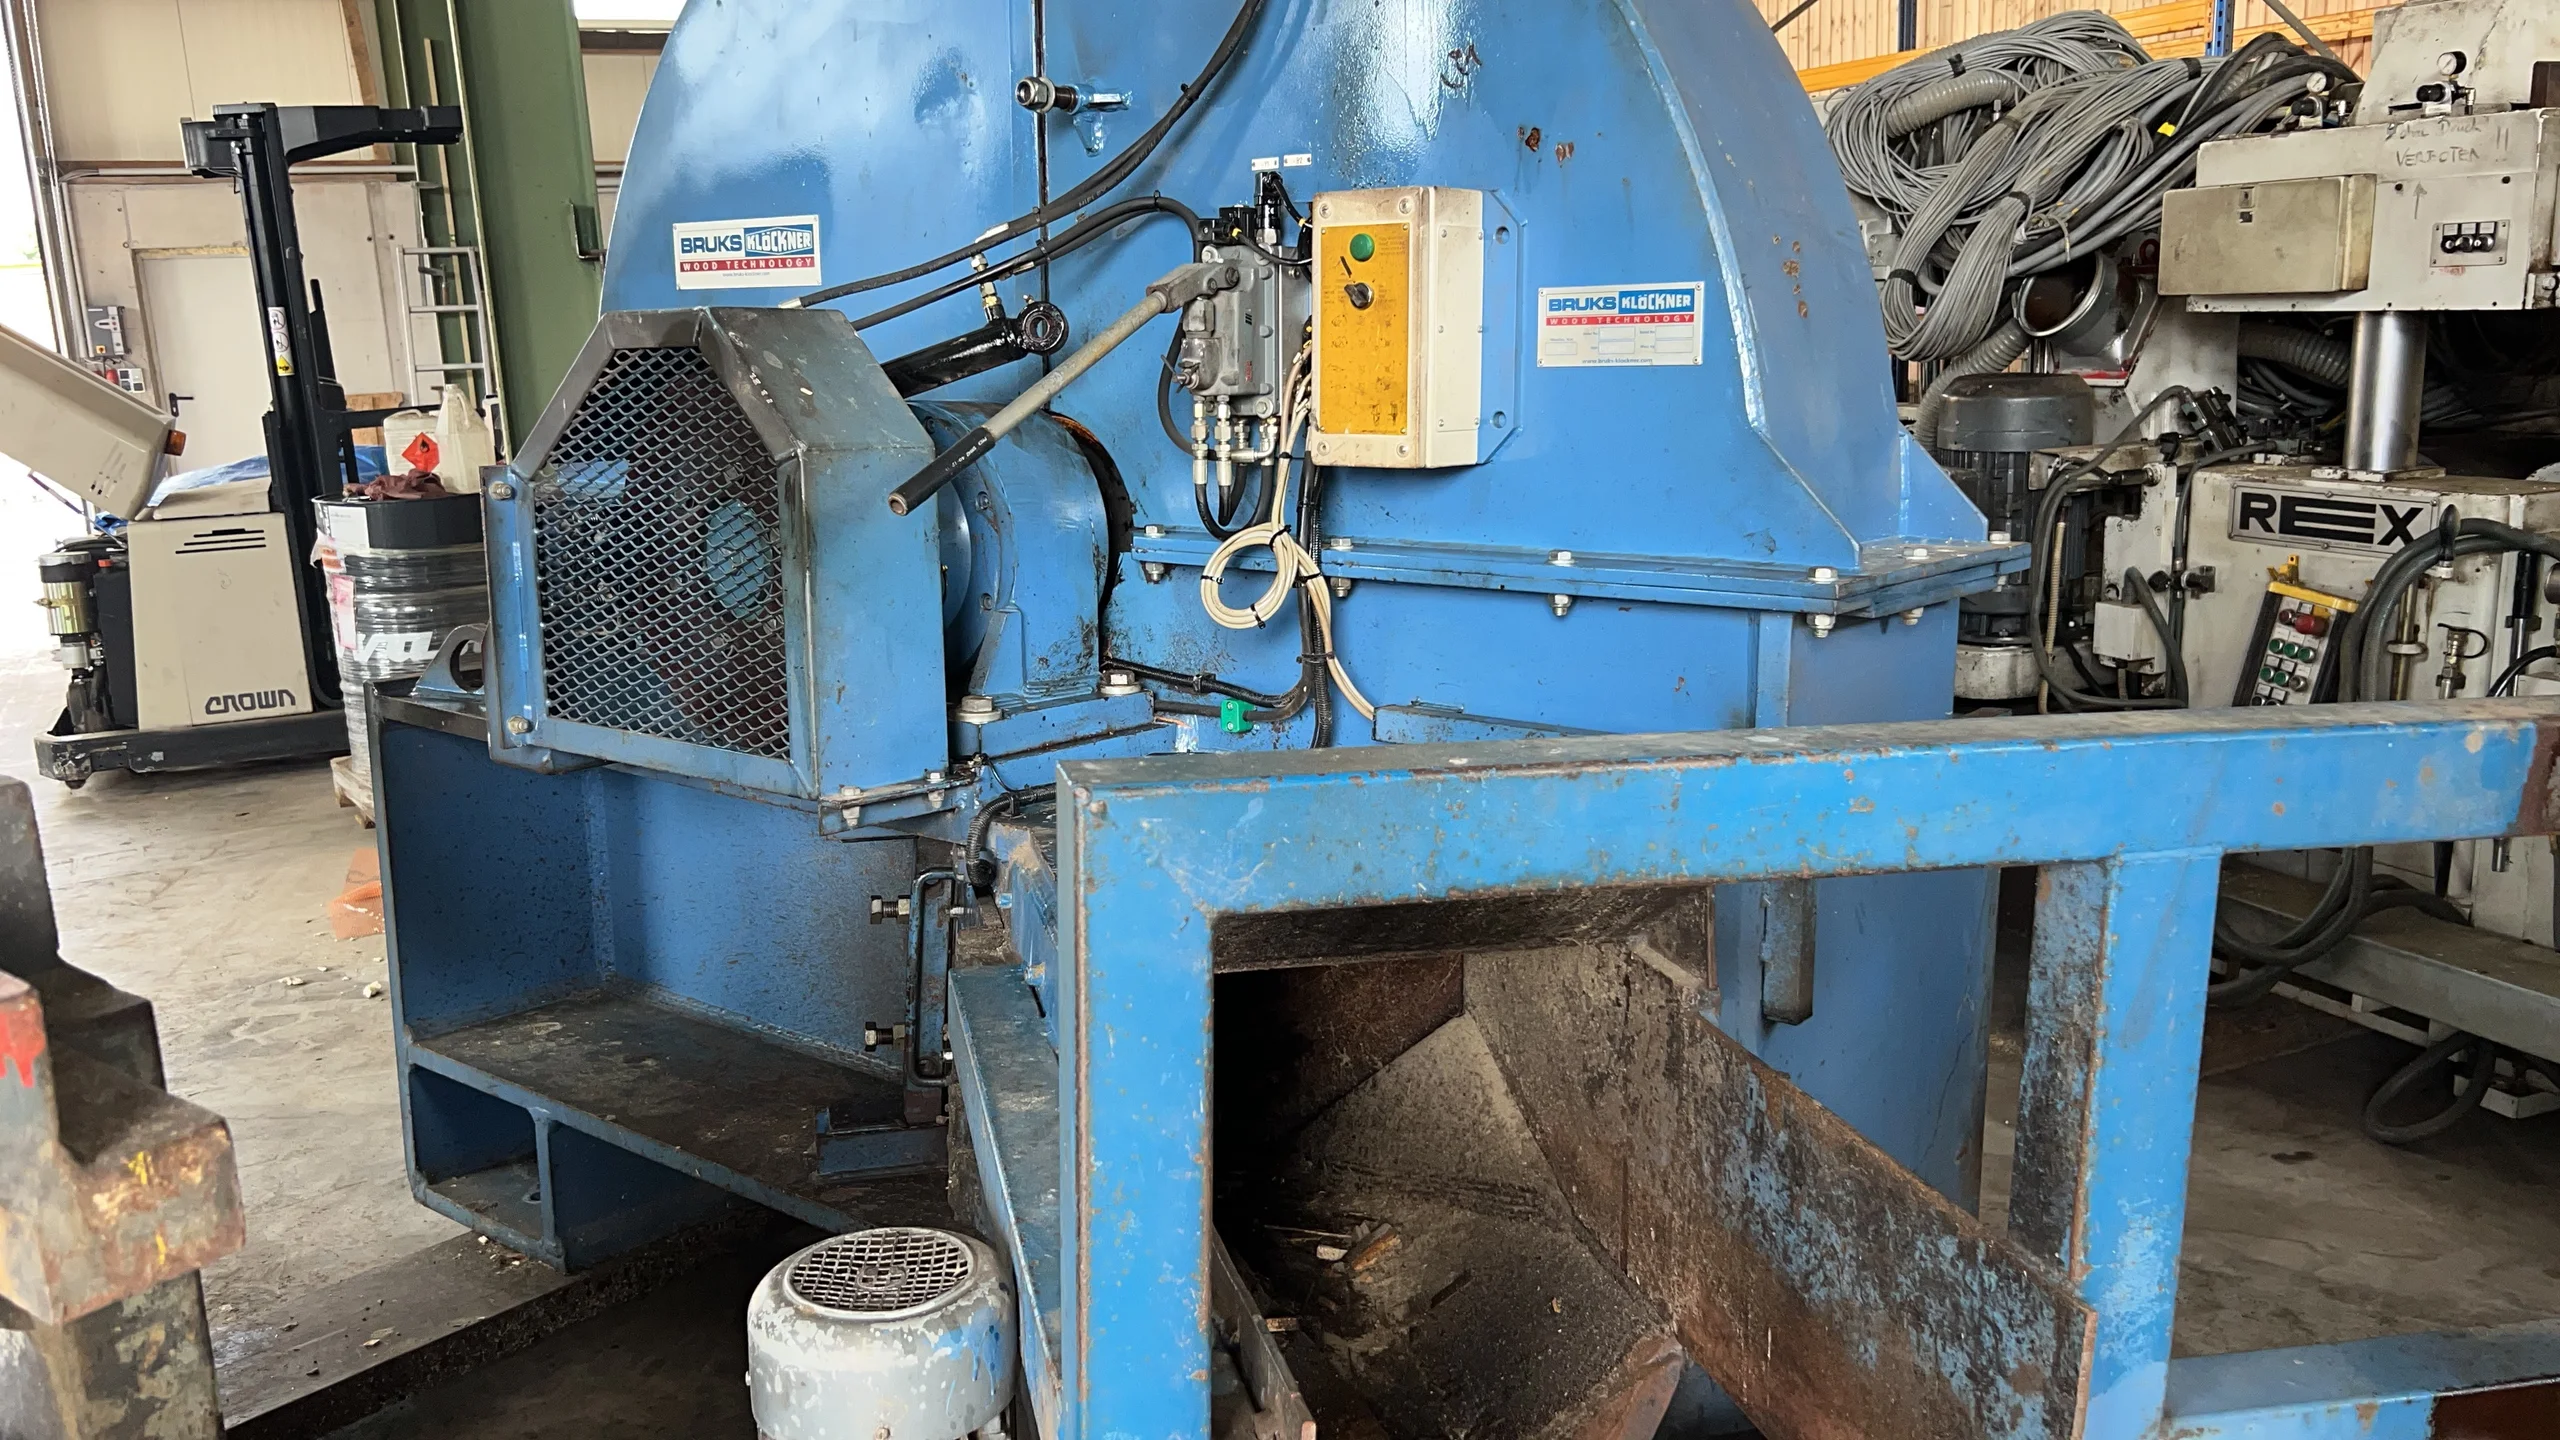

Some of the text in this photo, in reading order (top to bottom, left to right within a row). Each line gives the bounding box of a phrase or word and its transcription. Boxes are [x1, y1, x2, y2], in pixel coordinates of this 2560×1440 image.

[681, 230, 812, 253] BRUKS KLÖCKNER
[682, 258, 812, 271] WOOD TECHNOLOGY
[1549, 293, 1692, 311] BRUKS KLÖCKNER
[1550, 315, 1692, 325] WOOD TECHNOLOGY
[2239, 492, 2425, 548] REX
[205, 689, 296, 715] CROWN
